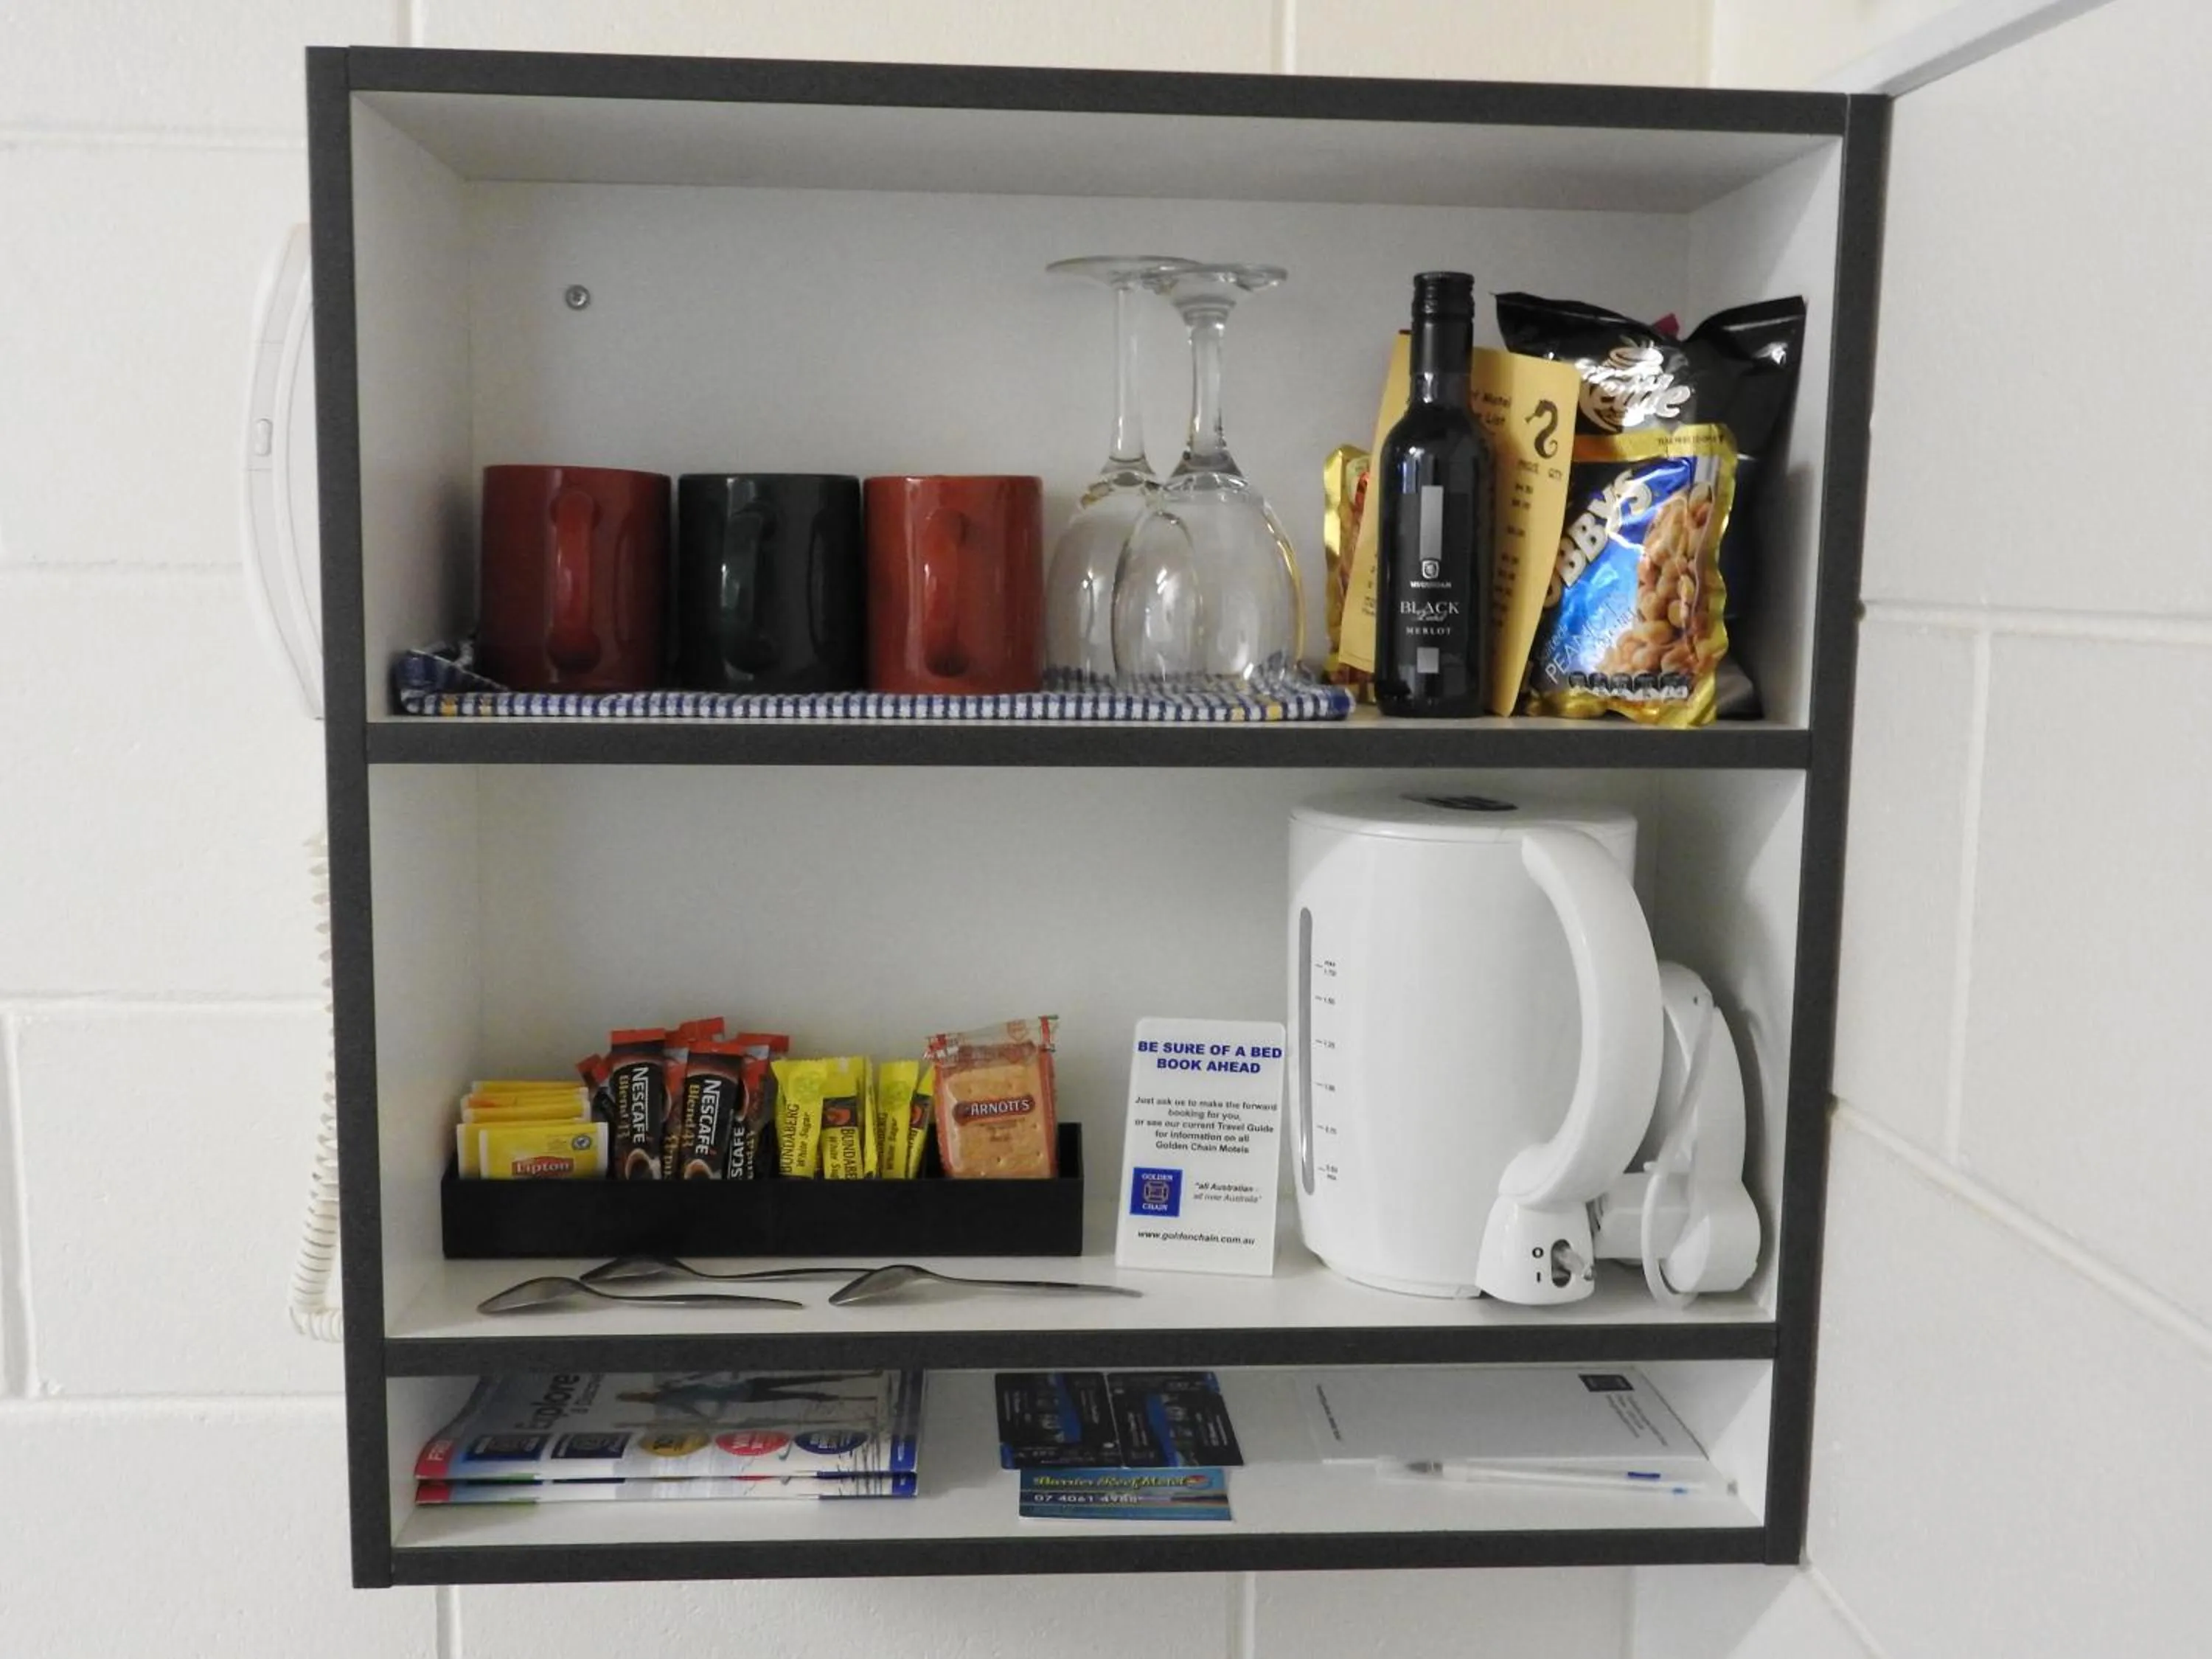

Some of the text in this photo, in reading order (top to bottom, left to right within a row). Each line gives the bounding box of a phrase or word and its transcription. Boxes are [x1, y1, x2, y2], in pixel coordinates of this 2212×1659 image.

[1400, 601, 1459, 614] BLACK
[1405, 627, 1450, 636] MERLOT
[1138, 1041, 1283, 1058] BE SURE OF A BED
[1157, 1058, 1261, 1074] BOOK AHEAD
[685, 1084, 700, 1129] Blend
[1135, 1096, 1154, 1105] Just
[1199, 1099, 1223, 1107] make
[1225, 1101, 1239, 1109] the
[1242, 1102, 1278, 1111] forward
[1168, 1108, 1204, 1119] booking
[1207, 1110, 1219, 1118] for
[1182, 1121, 1214, 1130] current
[1218, 1121, 1245, 1131] Travel
[1247, 1124, 1274, 1133] Guide
[781, 1102, 800, 1173] BUNDABERG
[1155, 1129, 1168, 1138] for
[1170, 1130, 1222, 1141] information
[1238, 1134, 1250, 1142] all
[841, 1128, 858, 1180] BUNDABE
[1155, 1141, 1250, 1154] Golden Chain Motels
[516, 1161, 570, 1175] Lipton
[1141, 1172, 1173, 1181] GOLDEN
[1142, 1202, 1169, 1211] CHAIN
[1137, 1230, 1256, 1245] www.goldenchain.com.au
[1034, 1494, 1053, 1502] 07
